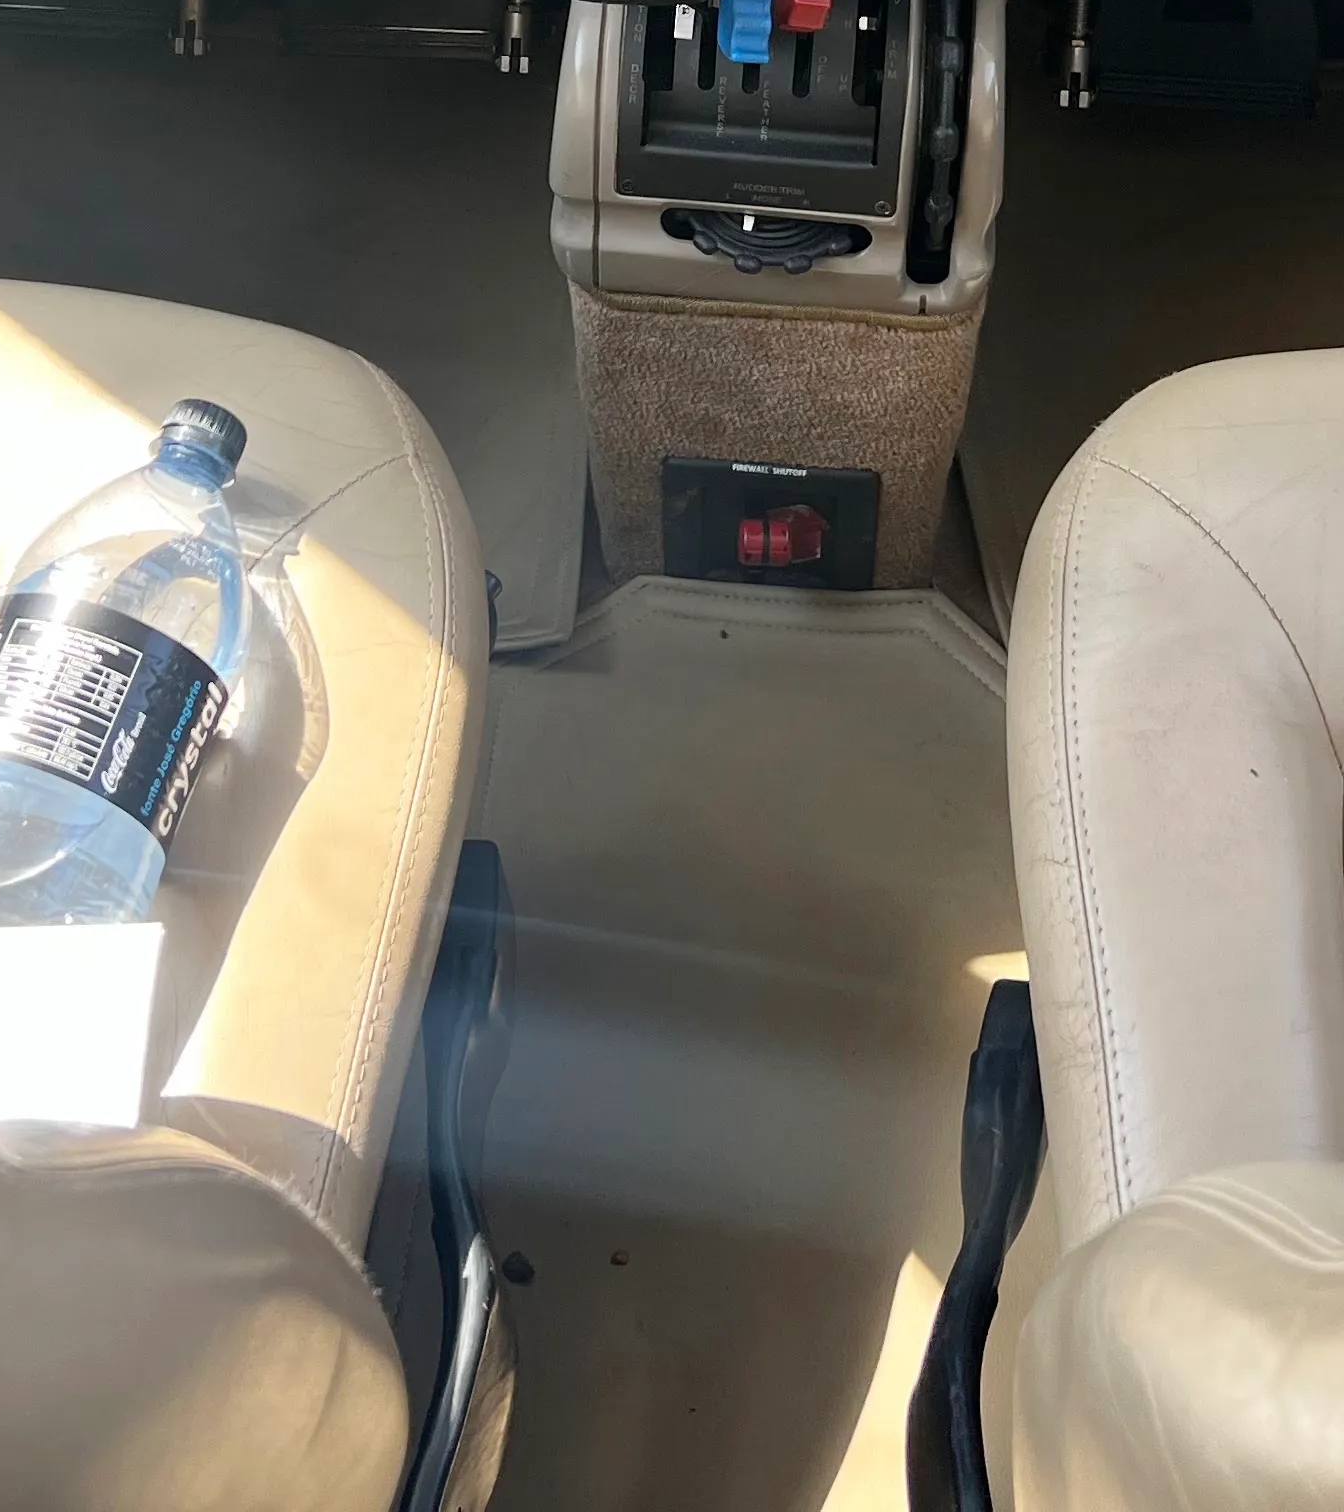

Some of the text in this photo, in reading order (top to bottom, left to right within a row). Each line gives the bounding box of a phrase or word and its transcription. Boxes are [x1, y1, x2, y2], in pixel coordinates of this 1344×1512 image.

[732, 463, 807, 477] FIREWALL SHUTOFF
[158, 681, 223, 837] crystal
[140, 777, 161, 817] fonte
